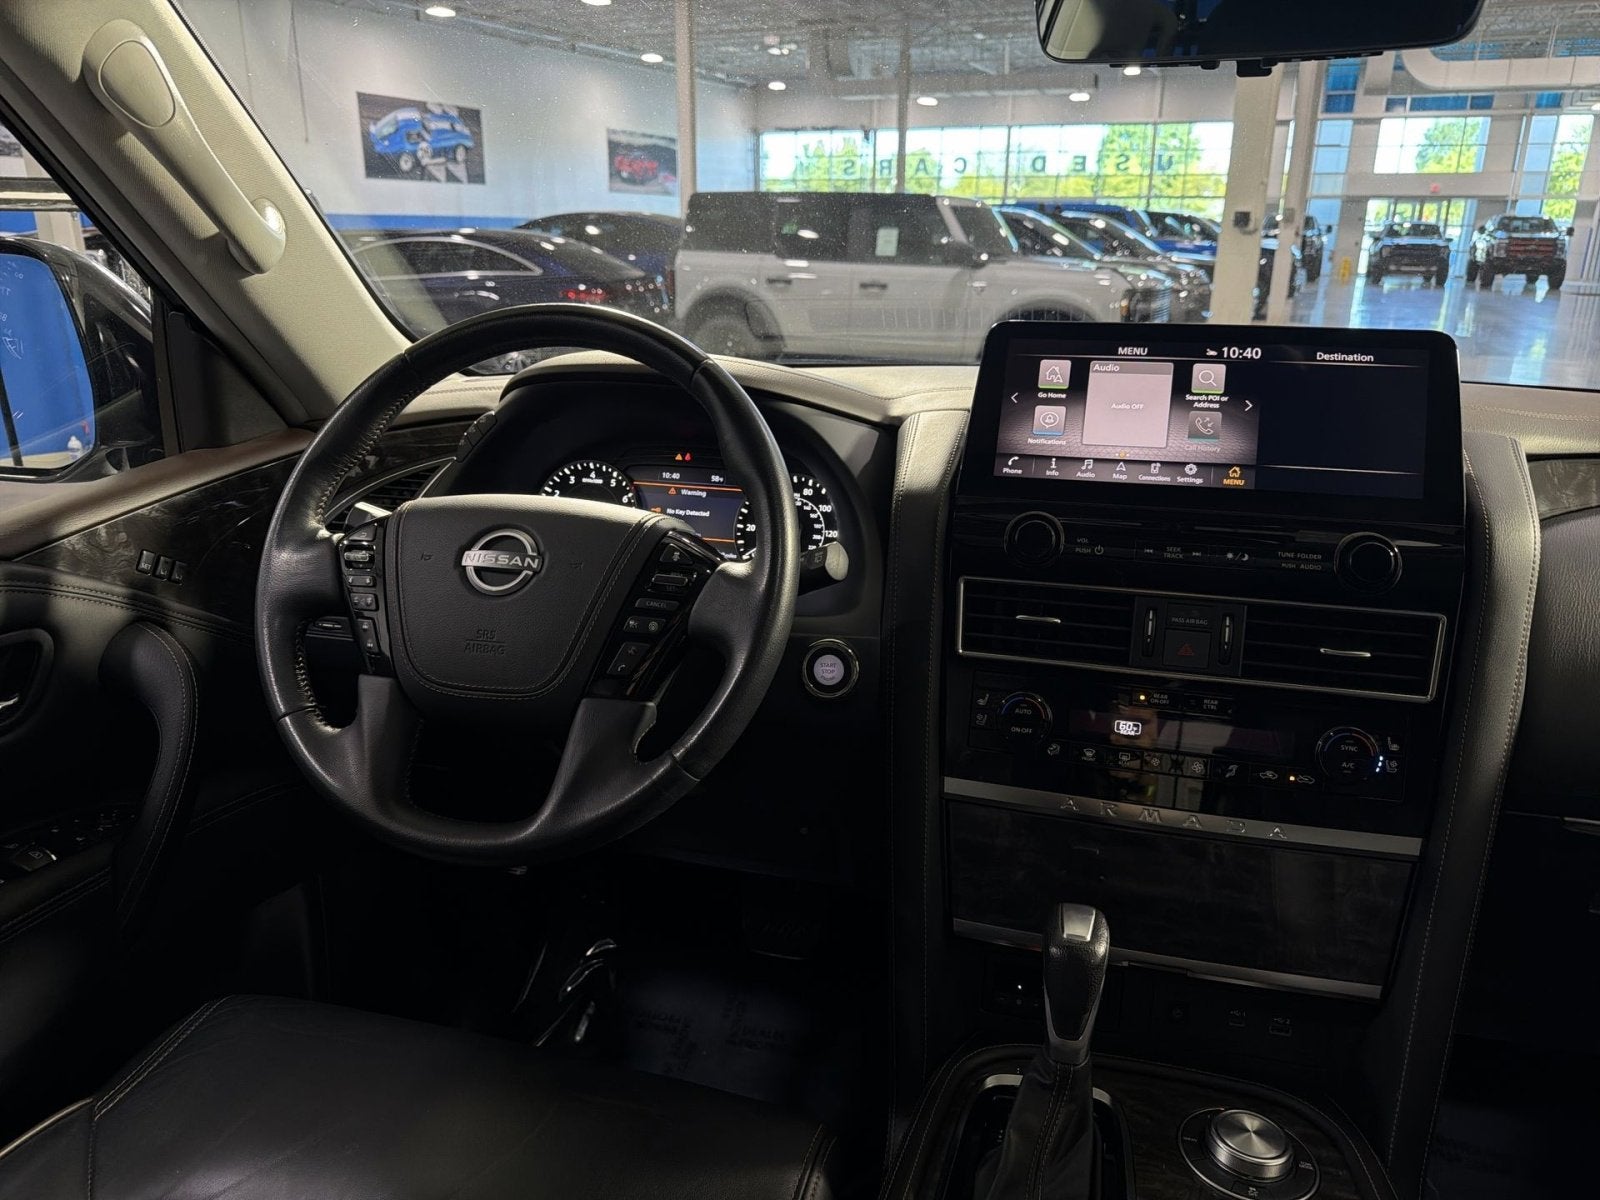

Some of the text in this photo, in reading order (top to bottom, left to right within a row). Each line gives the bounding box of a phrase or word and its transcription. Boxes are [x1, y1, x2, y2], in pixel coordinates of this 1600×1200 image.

[1118, 347, 1148, 356] MENU
[1221, 347, 1262, 359] 10:40
[1316, 351, 1374, 362] Destination
[1093, 363, 1120, 372] Audio
[1037, 391, 1049, 399] Go
[1185, 394, 1206, 402] Search
[1111, 402, 1129, 410] Audio
[1193, 401, 1220, 409] Address
[1027, 437, 1066, 446] Notifications
[589, 470, 596, 479] 4
[1002, 466, 1023, 475] Phone
[1045, 469, 1059, 477] Info
[1076, 470, 1096, 479] Audio
[568, 475, 576, 485] 3
[662, 472, 681, 480] 10:40
[1112, 473, 1128, 481] Map
[1138, 474, 1171, 482] Connections
[1176, 475, 1204, 485] Settings
[609, 478, 617, 488] 5
[1223, 478, 1245, 486] MENU
[680, 489, 707, 499] Warning
[802, 488, 814, 496] 80
[621, 494, 629, 503] 6
[675, 508, 686, 516] Key
[686, 509, 710, 517] Detected
[818, 504, 832, 513] 100
[745, 523, 756, 532] 20
[825, 530, 838, 538] 120
[463, 551, 540, 571] NISSAN
[463, 643, 506, 656] AIRBAG
[1059, 797, 1290, 840] ARMADA
